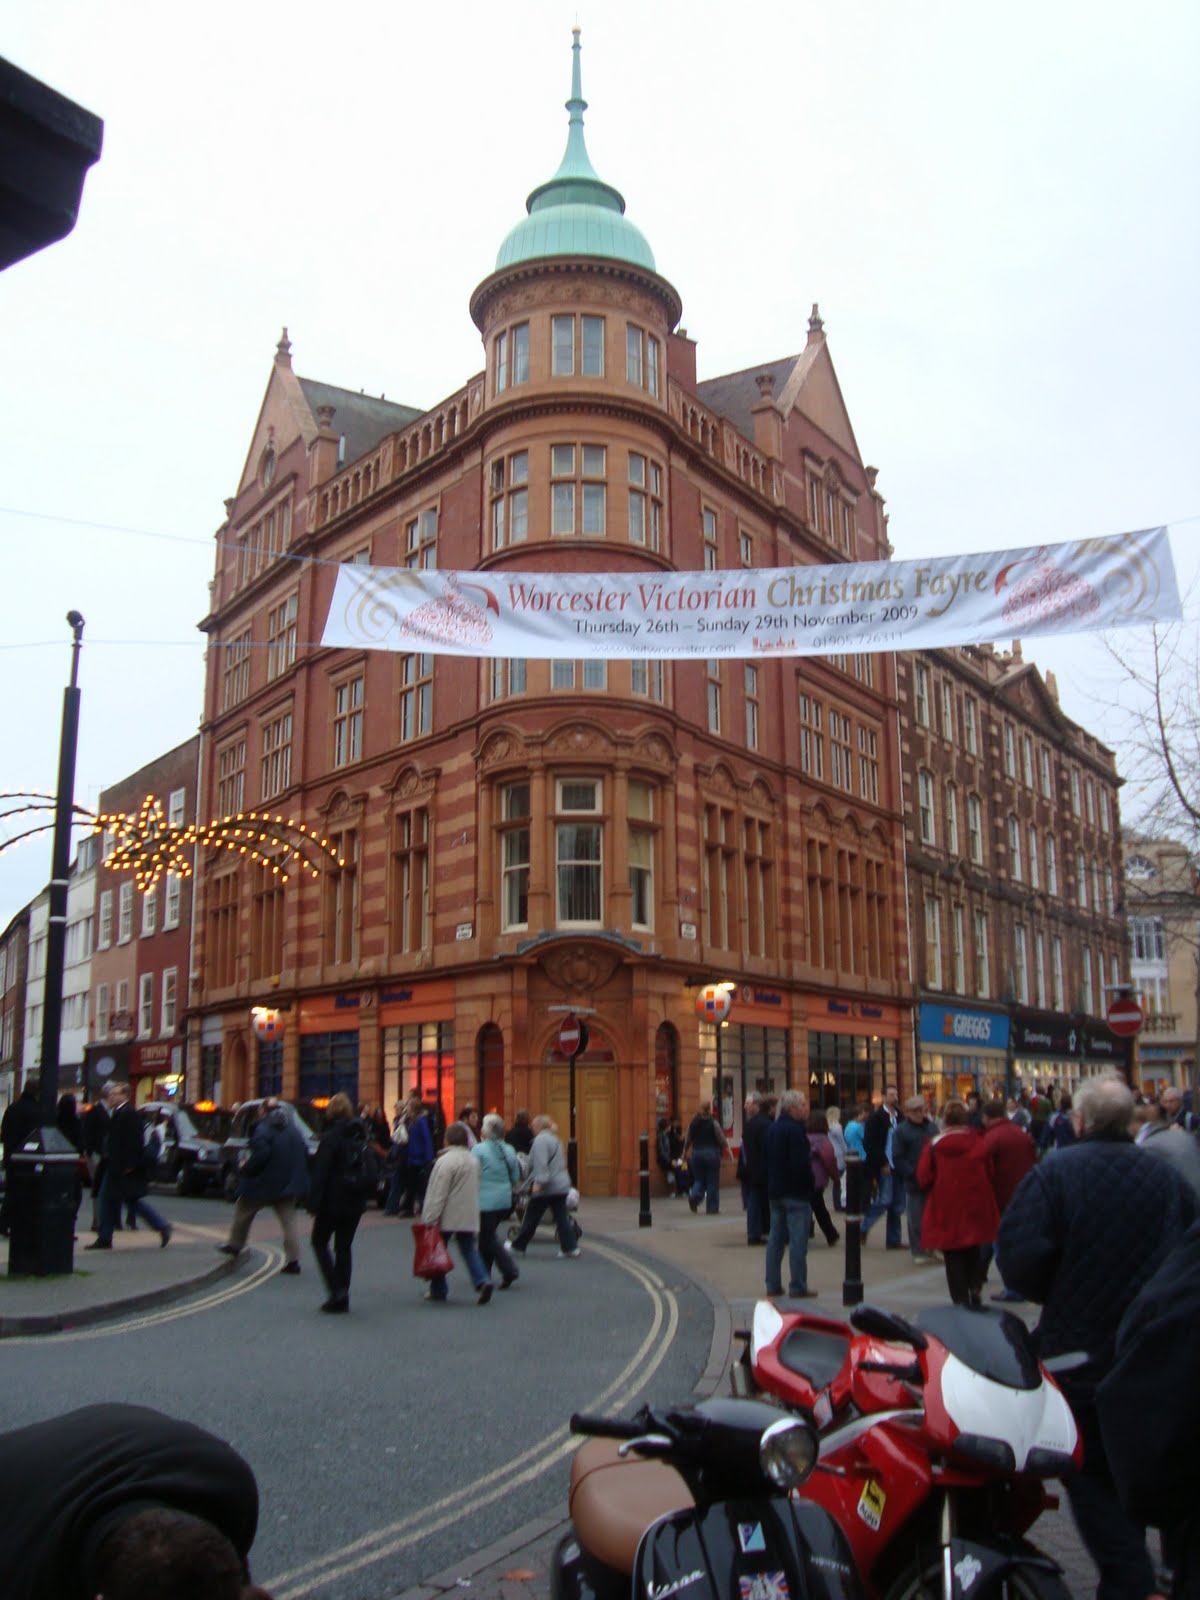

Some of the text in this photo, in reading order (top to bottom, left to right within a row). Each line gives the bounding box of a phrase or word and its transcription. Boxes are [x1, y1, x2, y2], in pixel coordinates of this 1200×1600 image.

[508, 567, 988, 617] Worcester Victorian Christmas Fayre
[574, 618, 641, 637] Thursday
[646, 619, 679, 633] 26th
[697, 618, 750, 634] Sunday
[755, 614, 788, 630] 29th
[794, 610, 876, 628] November
[881, 605, 918, 620] 2009
[593, 642, 736, 656] www.visitworcester.com
[954, 1013, 991, 1041] GREGGS
